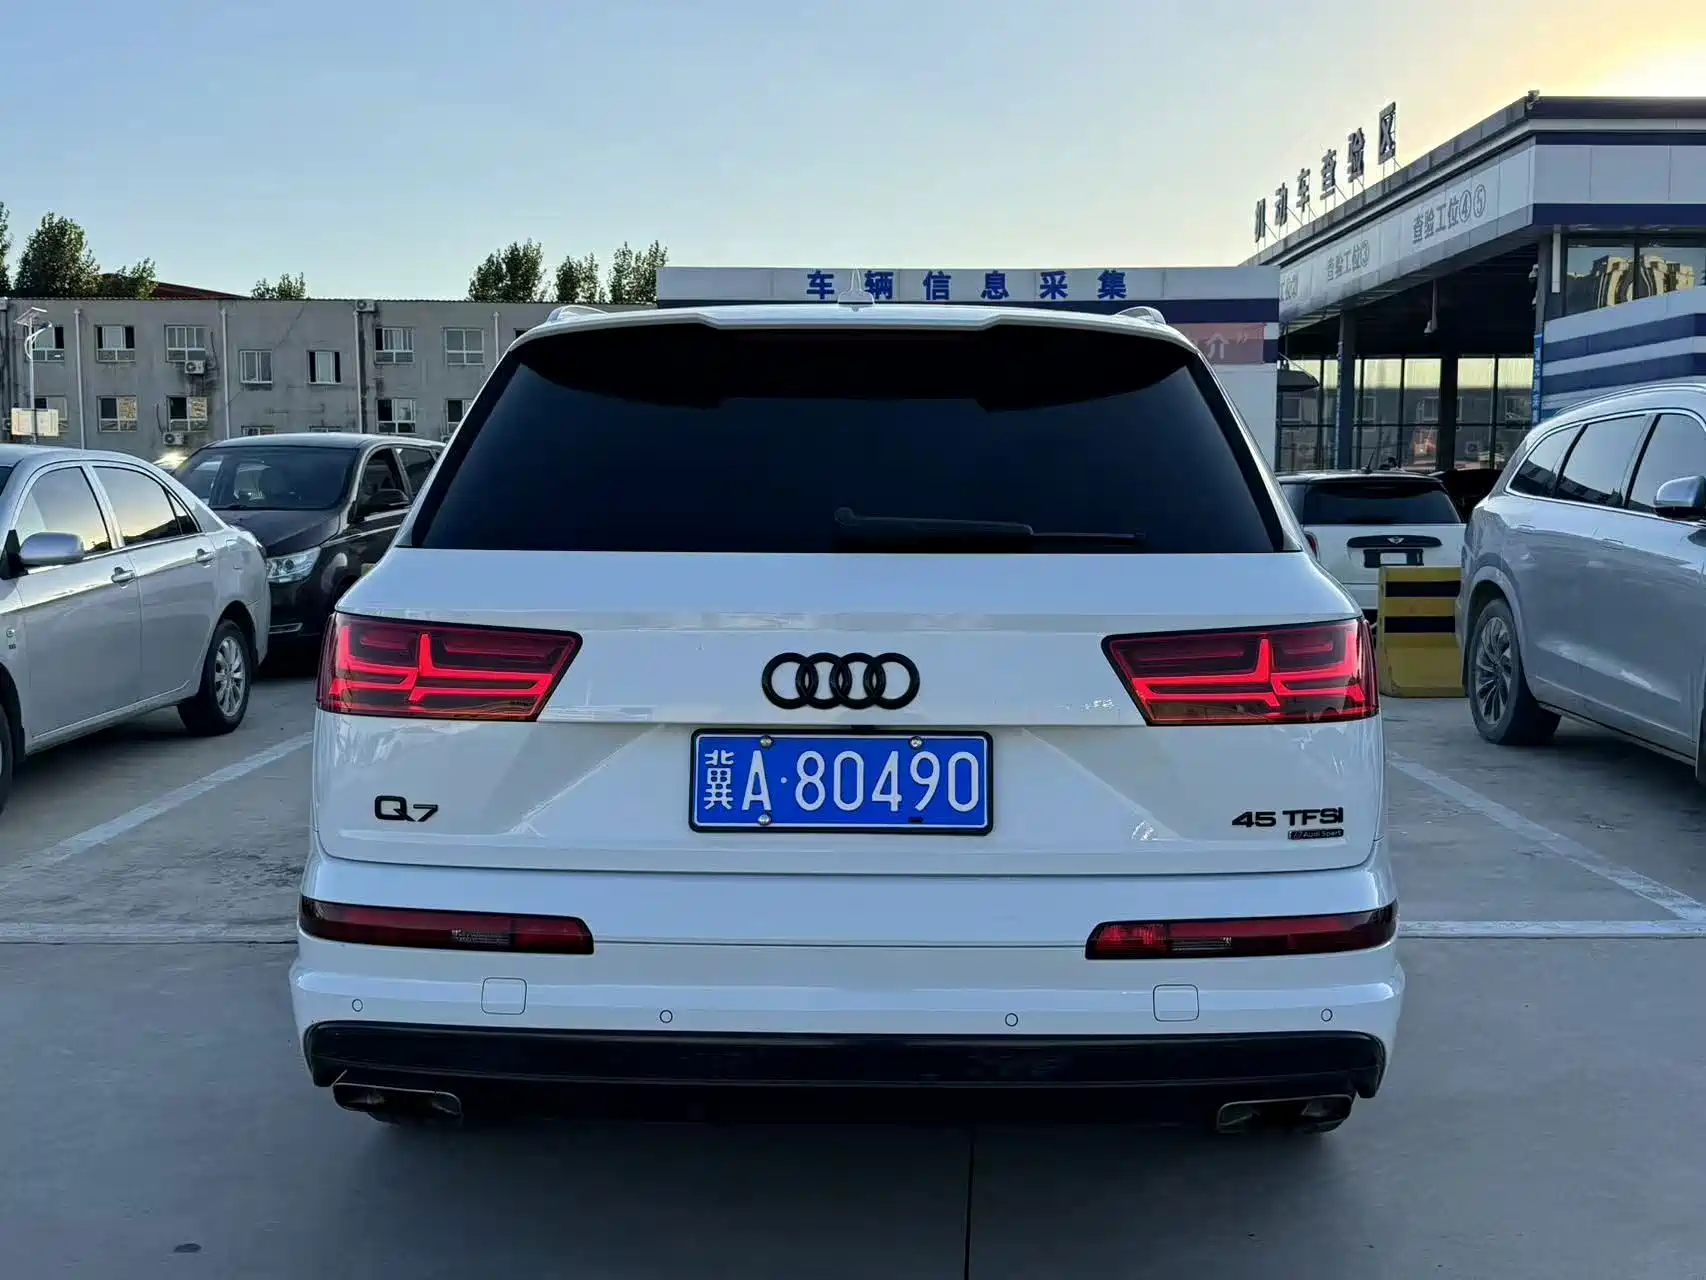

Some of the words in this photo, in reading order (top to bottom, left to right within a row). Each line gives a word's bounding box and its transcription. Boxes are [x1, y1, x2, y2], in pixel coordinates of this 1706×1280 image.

[1254, 101, 1396, 243] 机动车查验区
[806, 270, 1127, 300] 车辆信息采集
[704, 749, 980, 813] 冀A·80490
[374, 795, 438, 822] Q7
[1232, 811, 1277, 828] 45
[1282, 806, 1344, 827] TFSI
